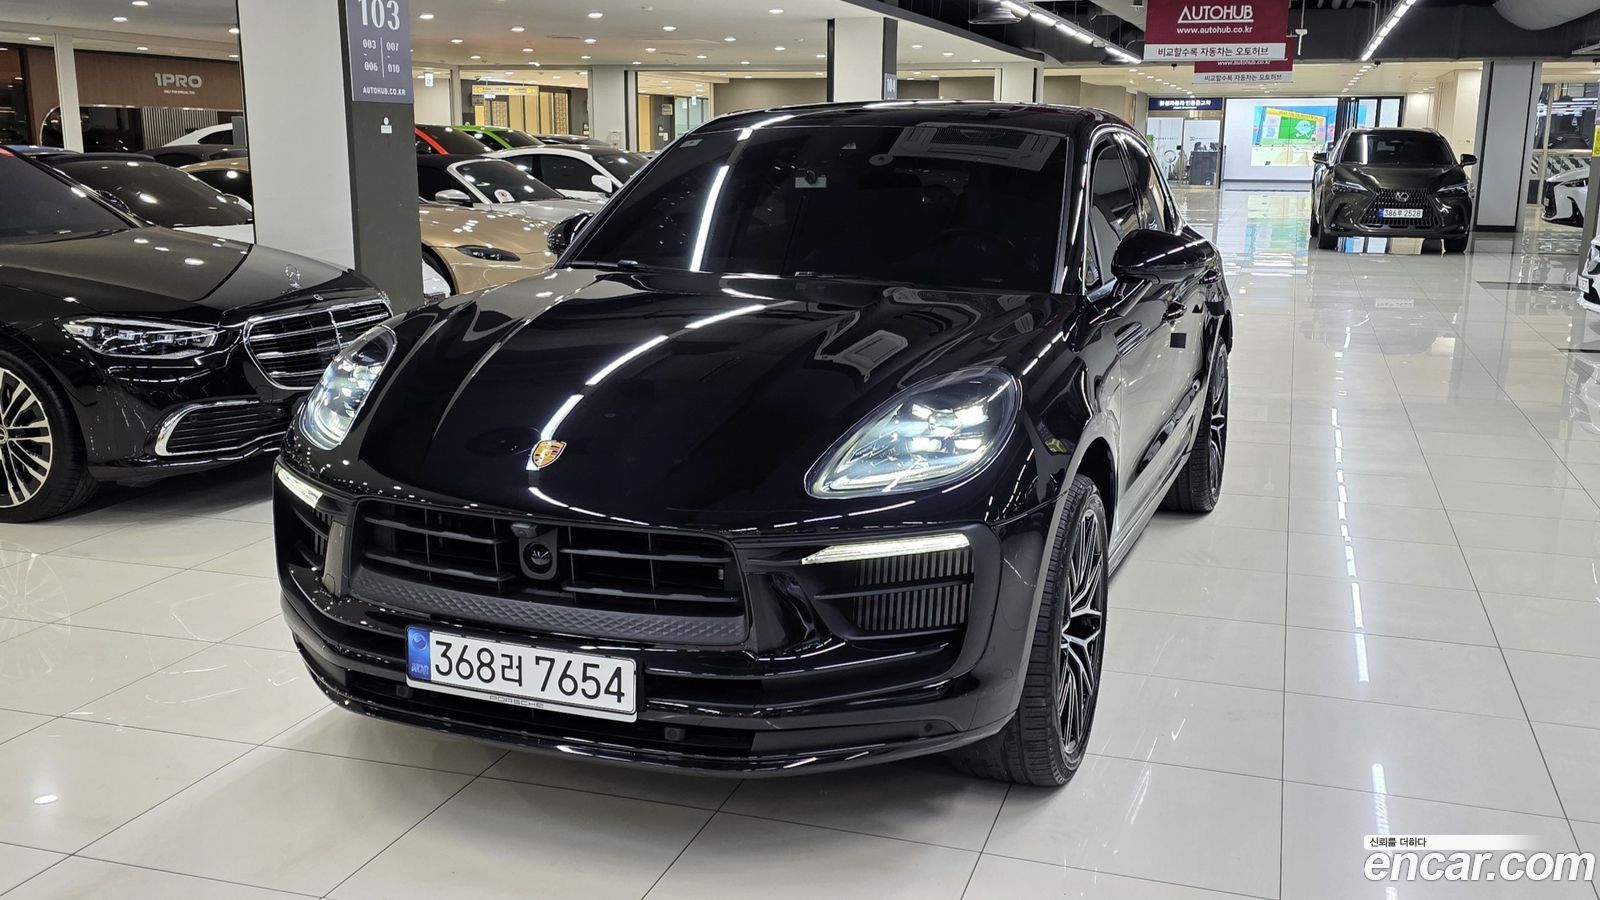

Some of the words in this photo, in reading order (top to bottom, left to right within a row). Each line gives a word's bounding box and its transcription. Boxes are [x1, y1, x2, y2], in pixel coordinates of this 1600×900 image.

[358, 0, 400, 30] 103
[1177, 5, 1254, 23] AUTOHUB
[1176, 25, 1253, 34] www.autohub.co.kr
[362, 38, 377, 49] 003
[386, 41, 399, 51] 007
[1158, 47, 1199, 57] 비교할수록
[1200, 47, 1234, 57] 자동차는
[1235, 47, 1269, 56] 오토허브
[364, 61, 378, 72] 006
[387, 63, 400, 73] 010
[154, 72, 202, 88] 1PRO
[1259, 73, 1282, 81] 오토허브
[363, 86, 406, 96] AUTOHUB.CO.KR
[434, 640, 523, 688] 368러
[534, 655, 625, 704] 7654
[490, 695, 544, 709] PORSCHE
